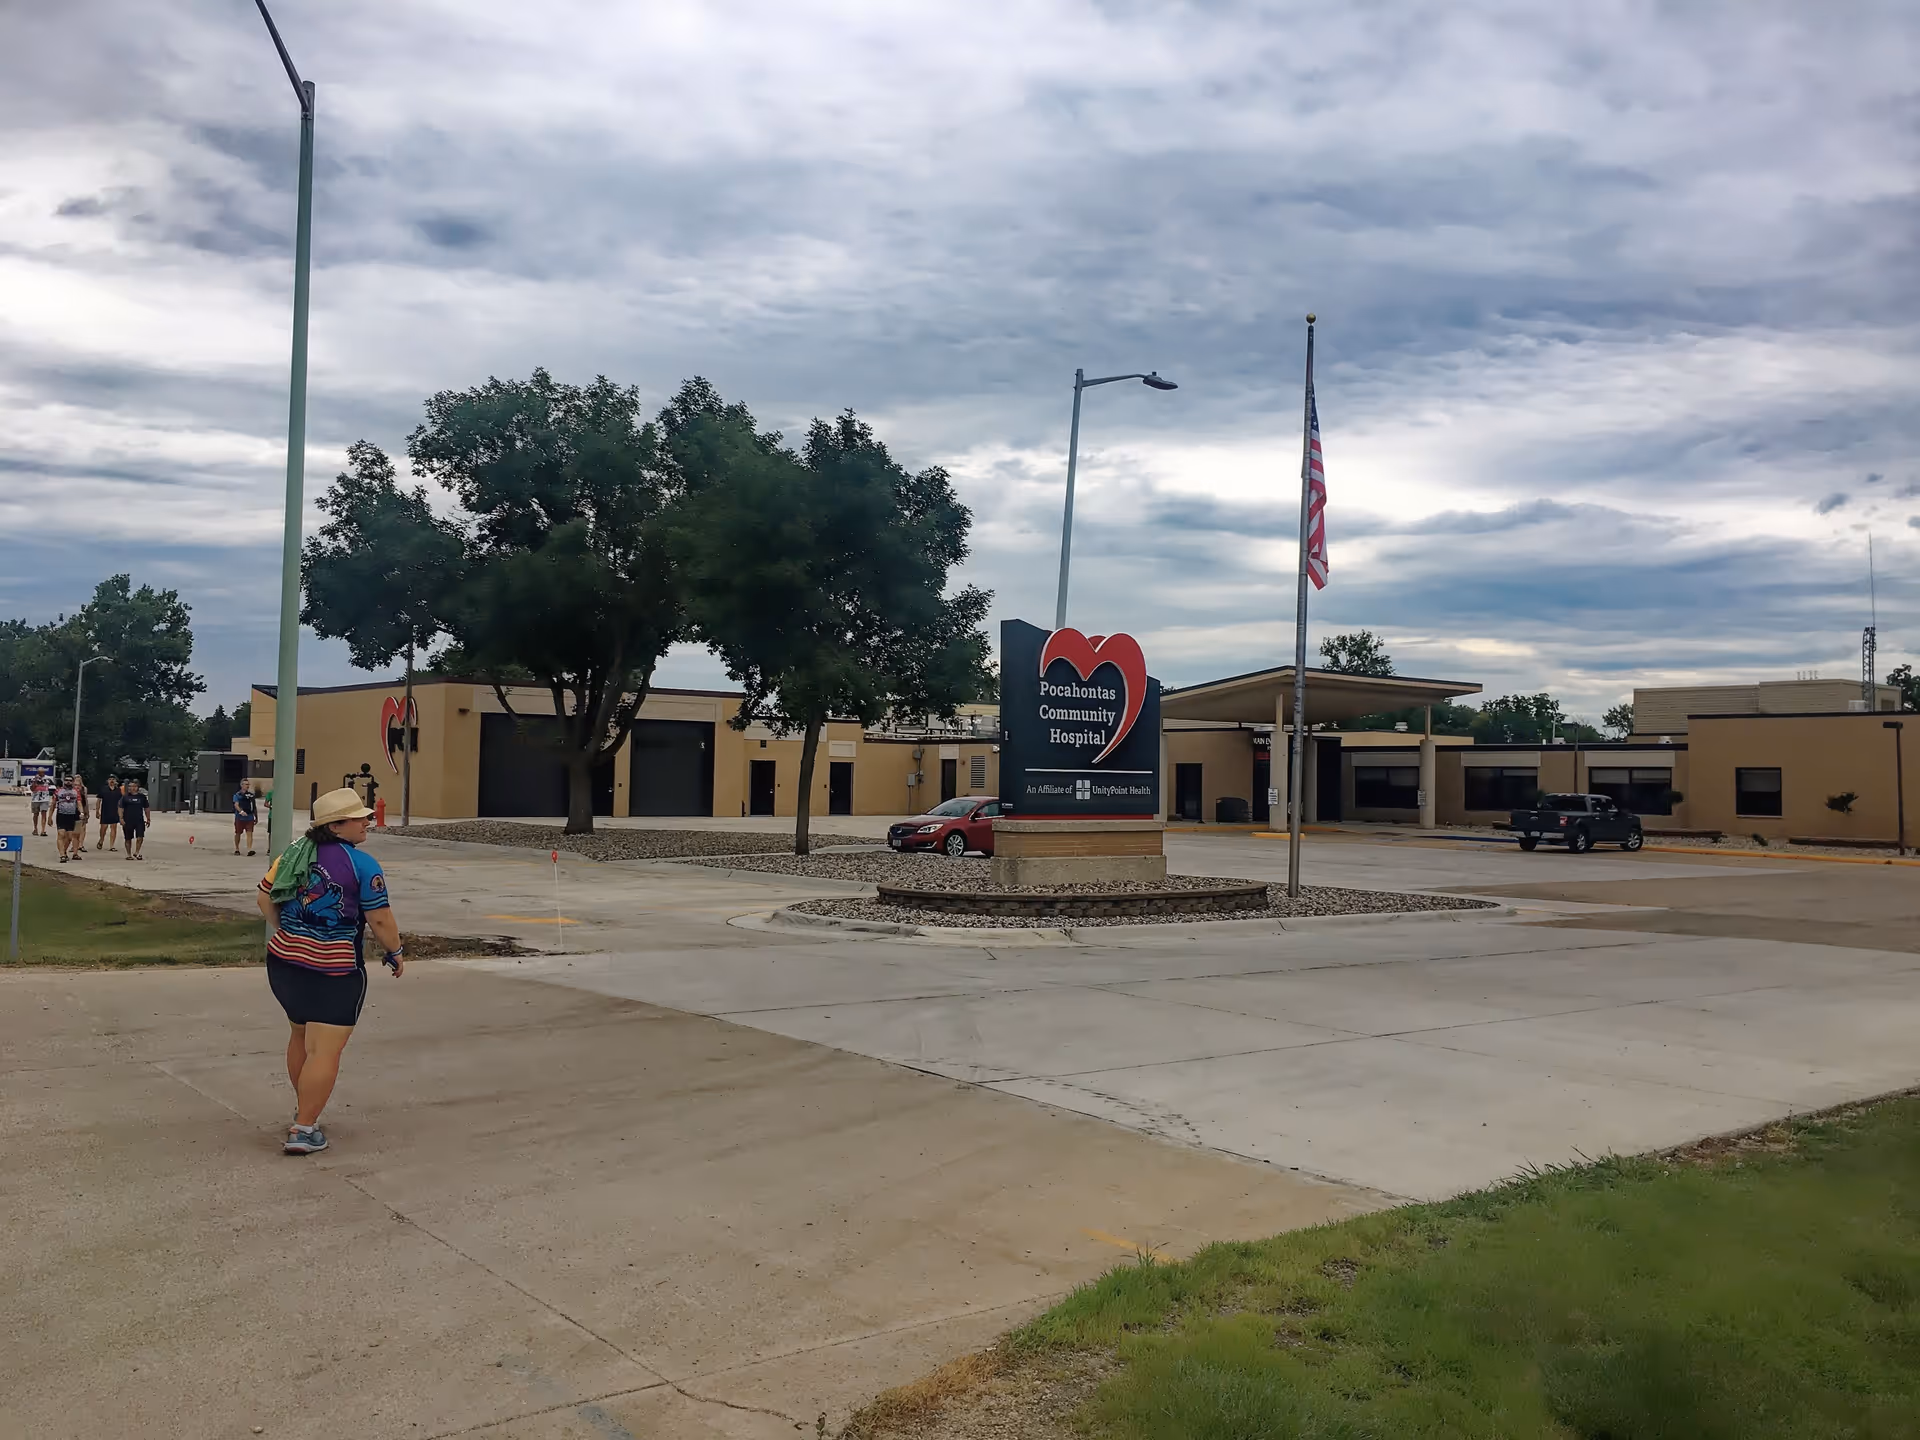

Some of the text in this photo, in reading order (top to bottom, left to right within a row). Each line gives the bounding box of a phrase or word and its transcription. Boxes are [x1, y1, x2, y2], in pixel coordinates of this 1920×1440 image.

[1039, 681, 1116, 700] Pocahontas
[1039, 704, 1116, 726] Community
[1049, 728, 1106, 748] Hospital
[1026, 784, 1151, 796] An Affiliate of UnityPoint Health
